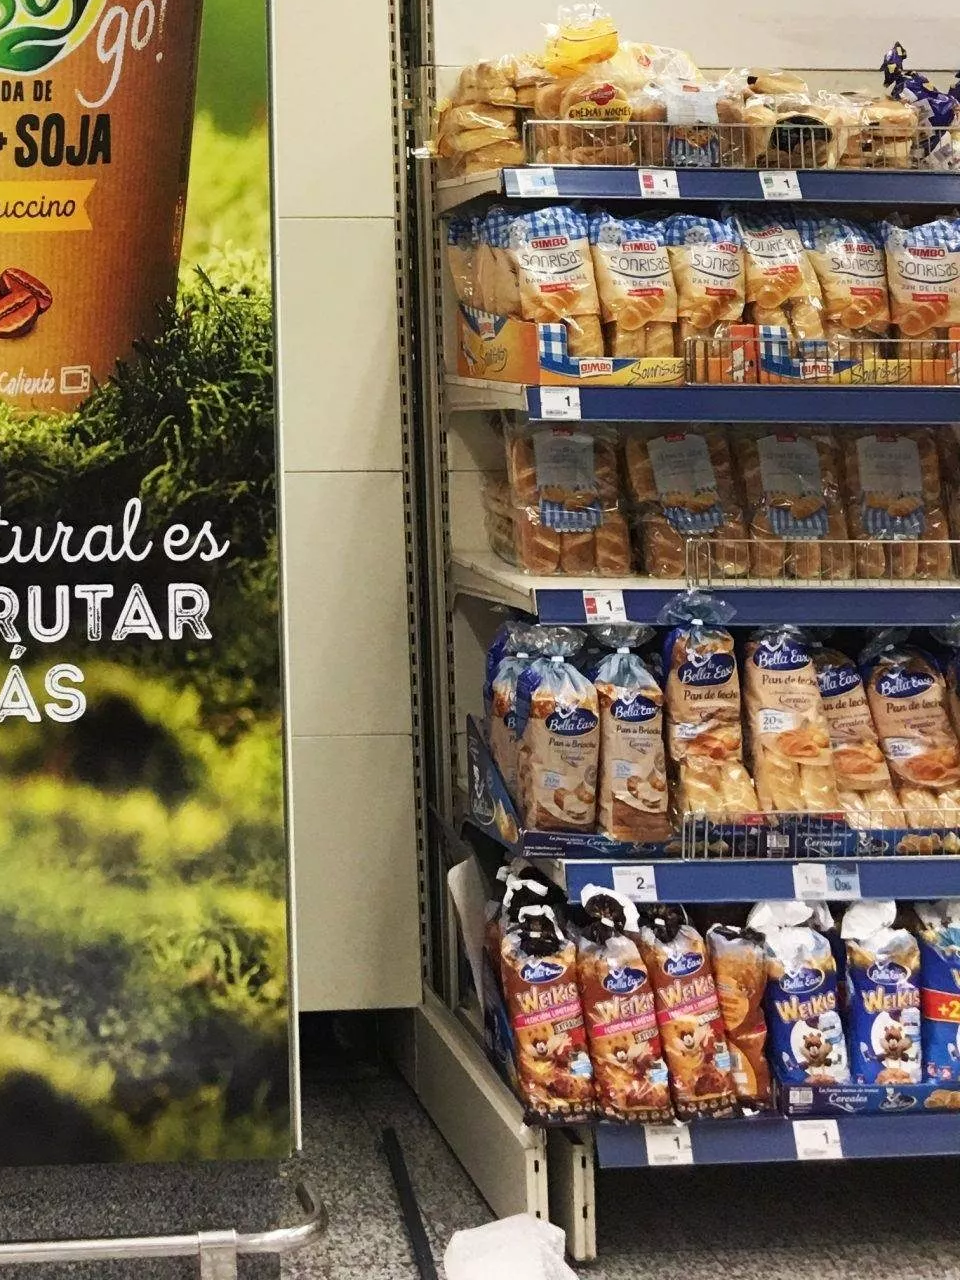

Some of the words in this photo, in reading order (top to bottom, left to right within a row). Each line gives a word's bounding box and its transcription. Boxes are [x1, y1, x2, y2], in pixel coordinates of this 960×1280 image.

[32, 80, 53, 103] DE
[14, 113, 113, 168] SOJA
[531, 237, 568, 249] BIMBO
[908, 247, 946, 258] BIMBO
[580, 363, 612, 372] BIMBO
[163, 521, 230, 563] es
[758, 652, 789, 669] Bella
[681, 666, 712, 684] Bella
[684, 689, 702, 701] Pan
[615, 704, 640, 718] Bella
[886, 702, 908, 714] Pan
[549, 718, 575, 731] Bella
[636, 876, 646, 890] 2
[828, 1092, 868, 1103] Cereales
